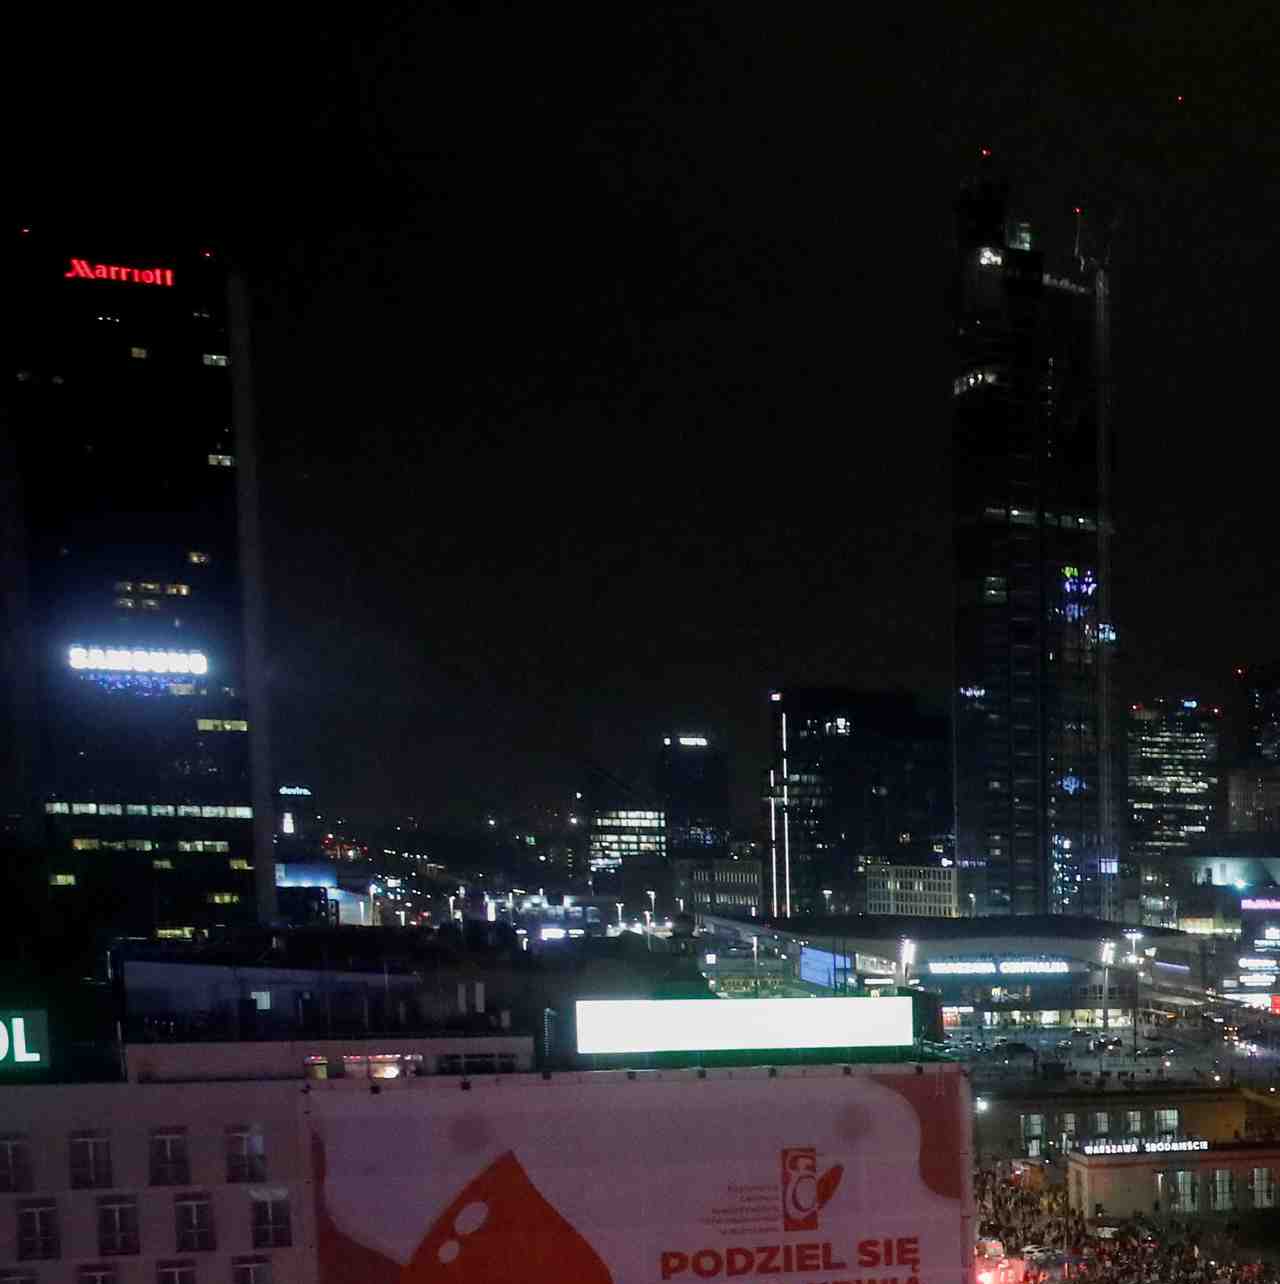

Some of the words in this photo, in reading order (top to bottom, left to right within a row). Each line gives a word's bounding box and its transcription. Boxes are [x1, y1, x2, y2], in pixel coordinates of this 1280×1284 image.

[65, 257, 174, 287] Marriott
[1084, 1144, 1138, 1155] WARSZAWA
[660, 1243, 846, 1280] PODZIEL
[857, 1237, 920, 1273] SIĘ
